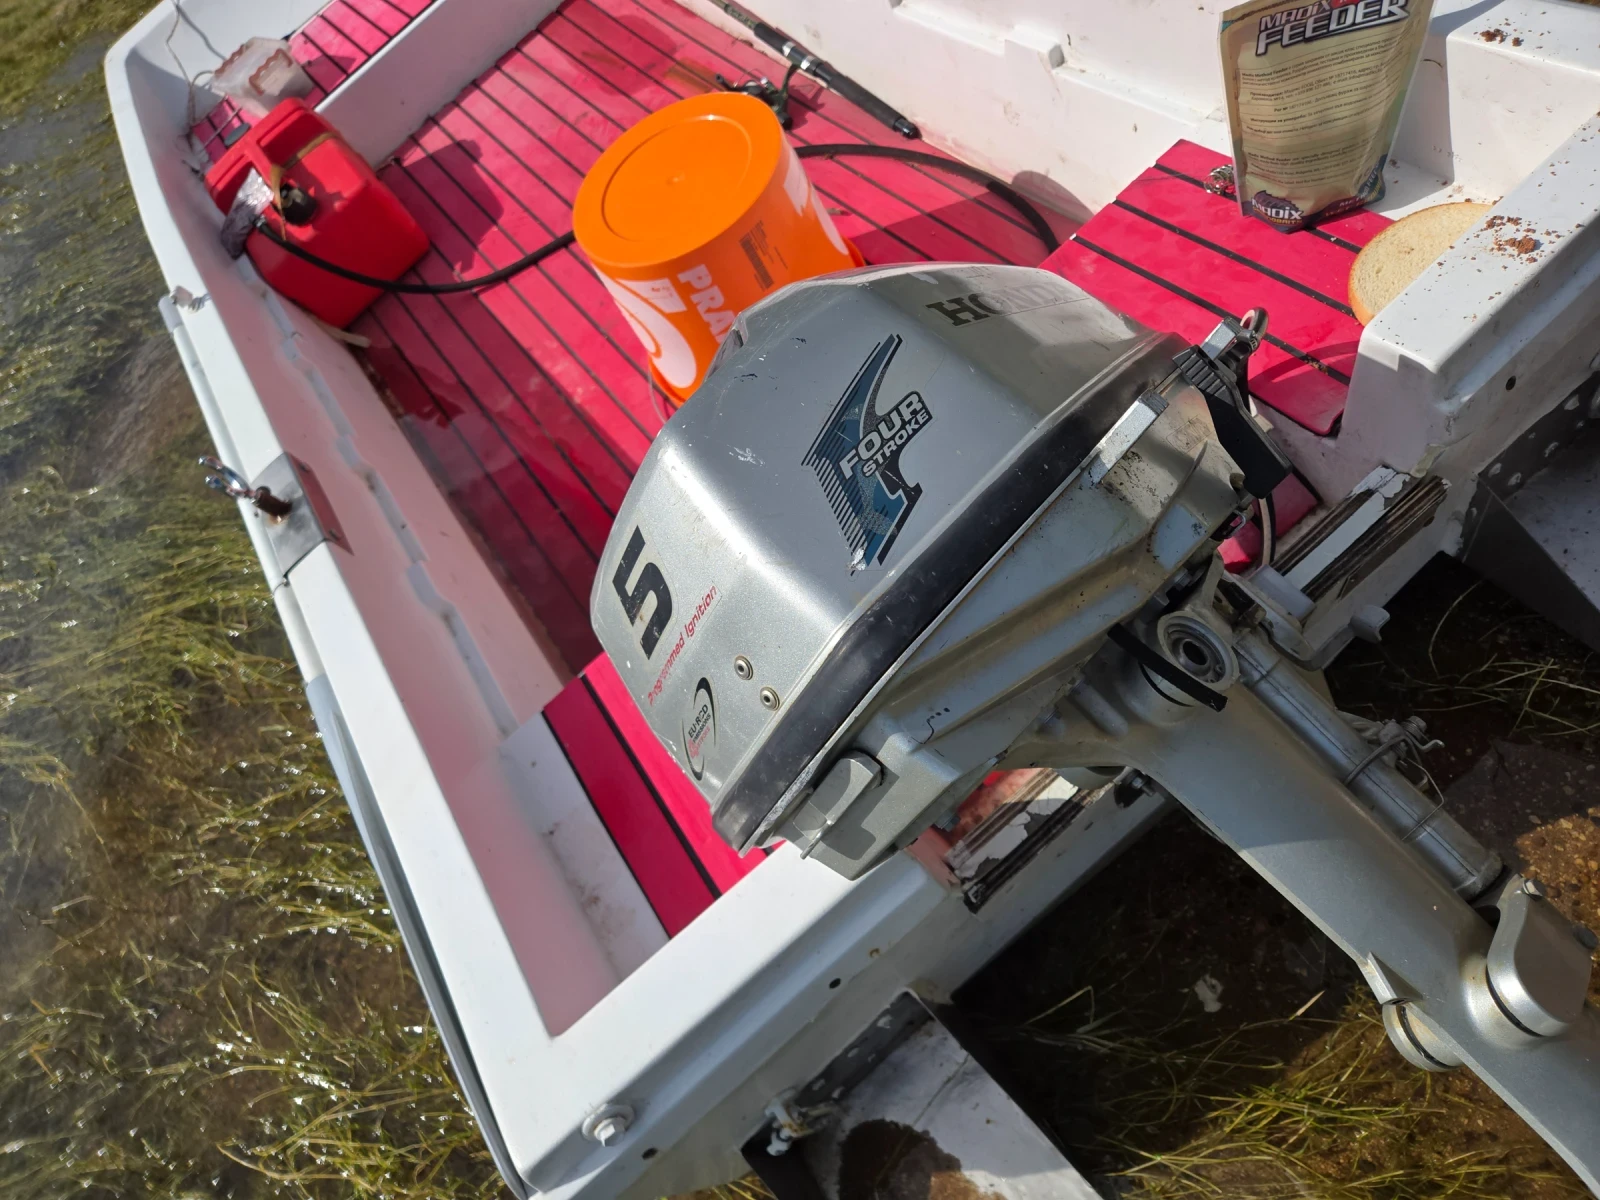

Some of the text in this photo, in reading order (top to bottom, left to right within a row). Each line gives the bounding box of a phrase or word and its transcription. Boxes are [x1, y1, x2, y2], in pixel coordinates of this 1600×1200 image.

[1256, 0, 1408, 56] FEEDER
[677, 264, 738, 344] PRA
[838, 392, 924, 480] FOUR
[862, 409, 929, 477] STROKE
[612, 525, 672, 660] 5
[684, 585, 718, 638] Ignition
